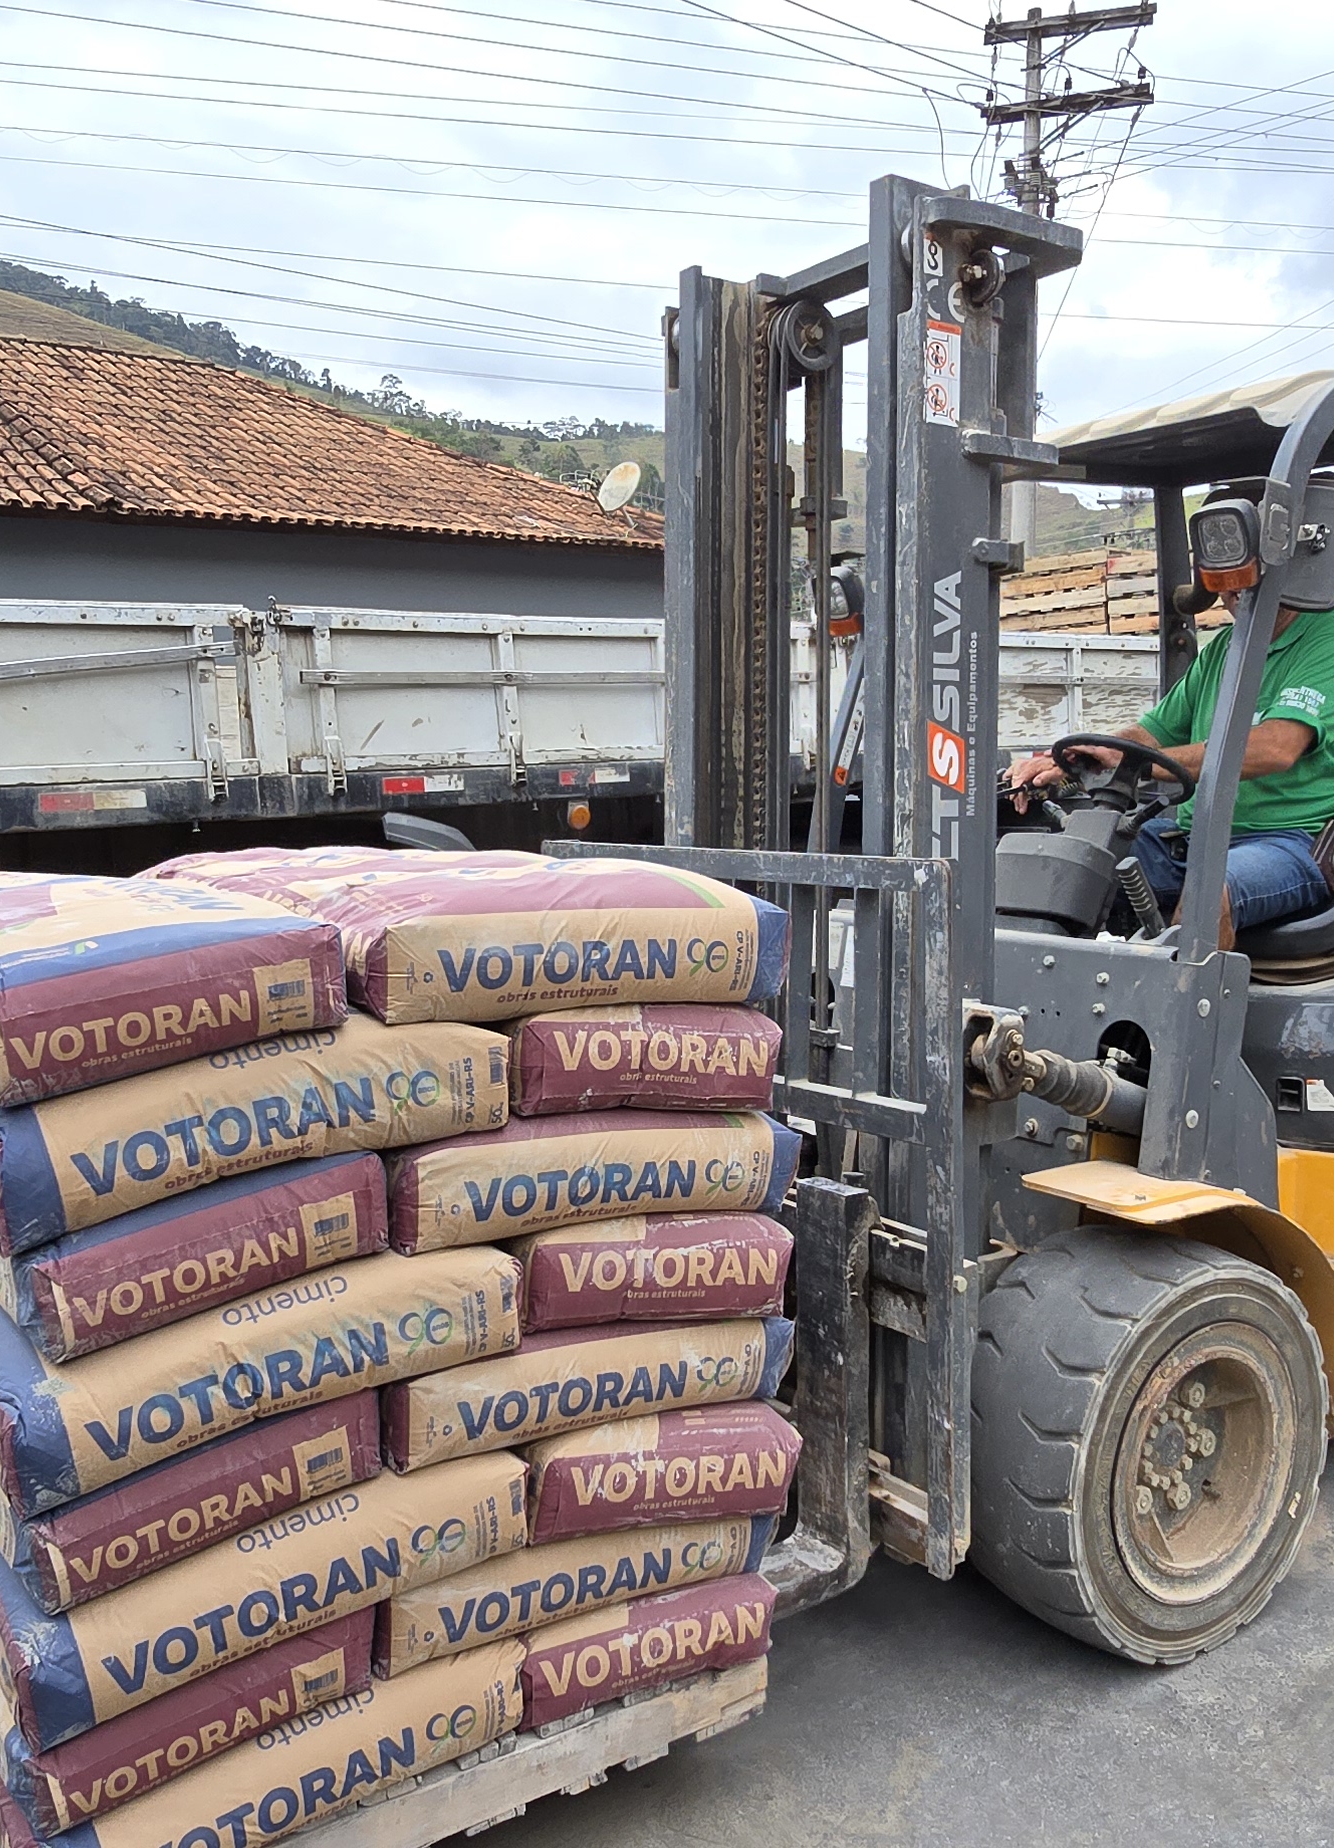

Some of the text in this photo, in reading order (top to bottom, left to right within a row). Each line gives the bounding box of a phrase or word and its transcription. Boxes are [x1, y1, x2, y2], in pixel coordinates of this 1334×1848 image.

[437, 938, 677, 993] VOTORAN
[540, 984, 618, 1001] estruturais
[10, 990, 252, 1070] VOTORAN
[81, 1037, 193, 1069] obras estruturais
[208, 1029, 336, 1070] cimento
[553, 1029, 769, 1078] VOTORAN
[644, 1072, 697, 1085] estruturais
[71, 1077, 377, 1197] VOTORAN
[217, 1140, 315, 1176] estruturais
[464, 1158, 697, 1222] VOTORAN
[72, 1227, 299, 1327] VOTORAN
[558, 1247, 779, 1293] VOTORAN
[651, 1287, 706, 1300] estruturais
[141, 1302, 176, 1320] obras
[222, 1275, 348, 1326] cimento
[84, 1321, 390, 1461] VOTORAN
[457, 1360, 688, 1441] VOTORAN
[570, 1450, 786, 1506] VOTORAN
[633, 1495, 715, 1511] obras estruturais
[69, 1466, 293, 1583] VOTORAN
[136, 1519, 239, 1570] obras estruturais
[236, 1493, 360, 1553] cimento
[101, 1537, 401, 1696] VOTORAN
[438, 1548, 672, 1643] VOTORAN
[538, 1602, 765, 1697] VOTORAN
[256, 1686, 374, 1750] cimento
[69, 1689, 288, 1813] VOTORAN
[157, 1727, 416, 1848] OTORAN
